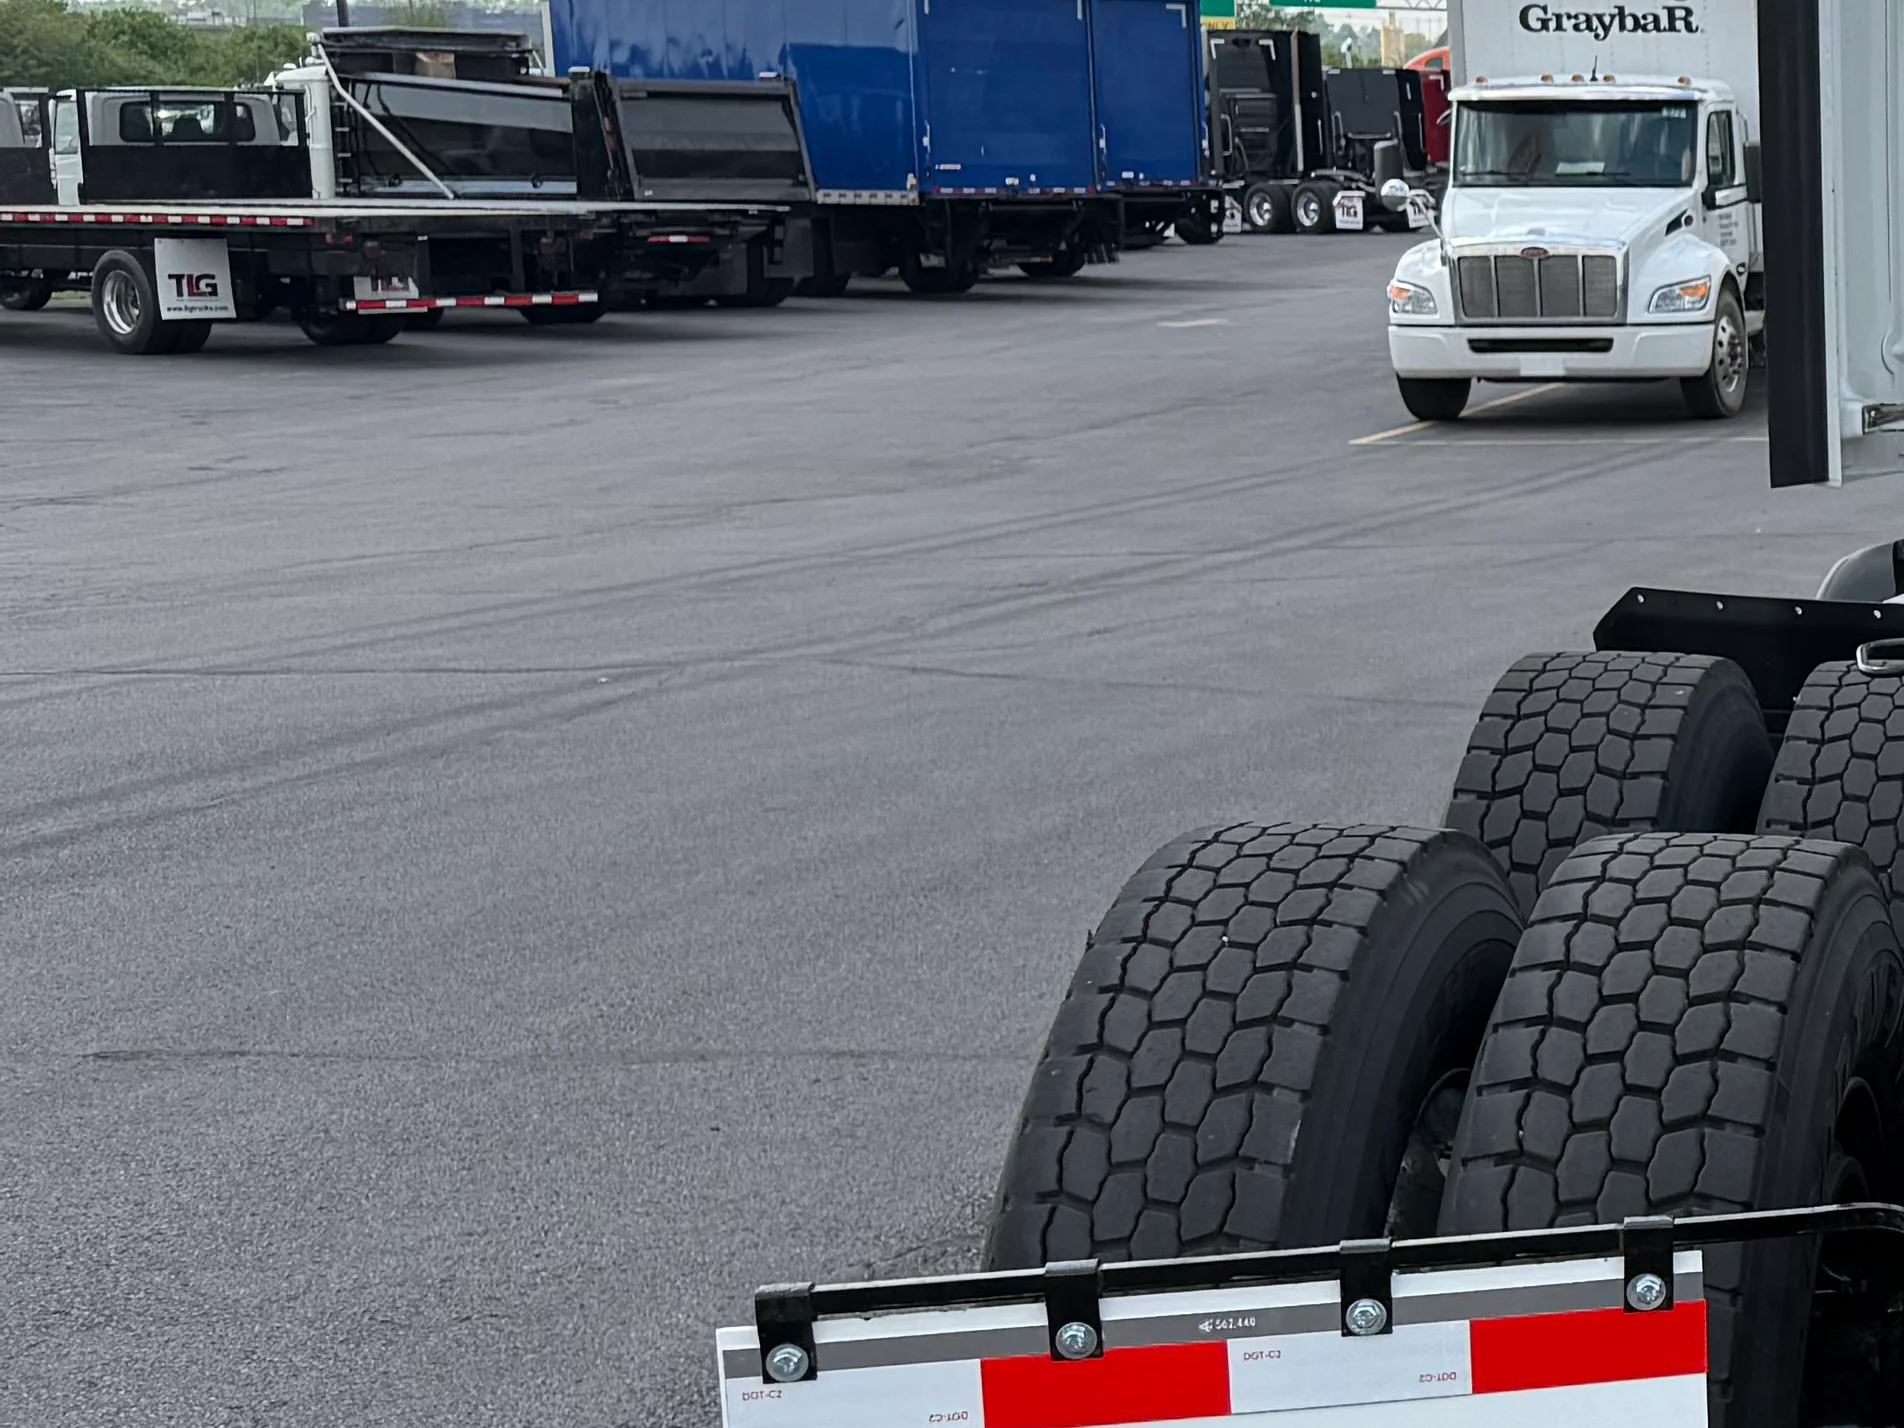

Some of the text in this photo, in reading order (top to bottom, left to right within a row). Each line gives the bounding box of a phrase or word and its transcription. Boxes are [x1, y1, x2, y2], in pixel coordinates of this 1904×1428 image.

[168, 273, 219, 298] TLG
[1243, 1350, 1282, 1361] DOT-C2
[742, 1390, 783, 1402] DOT-C2
